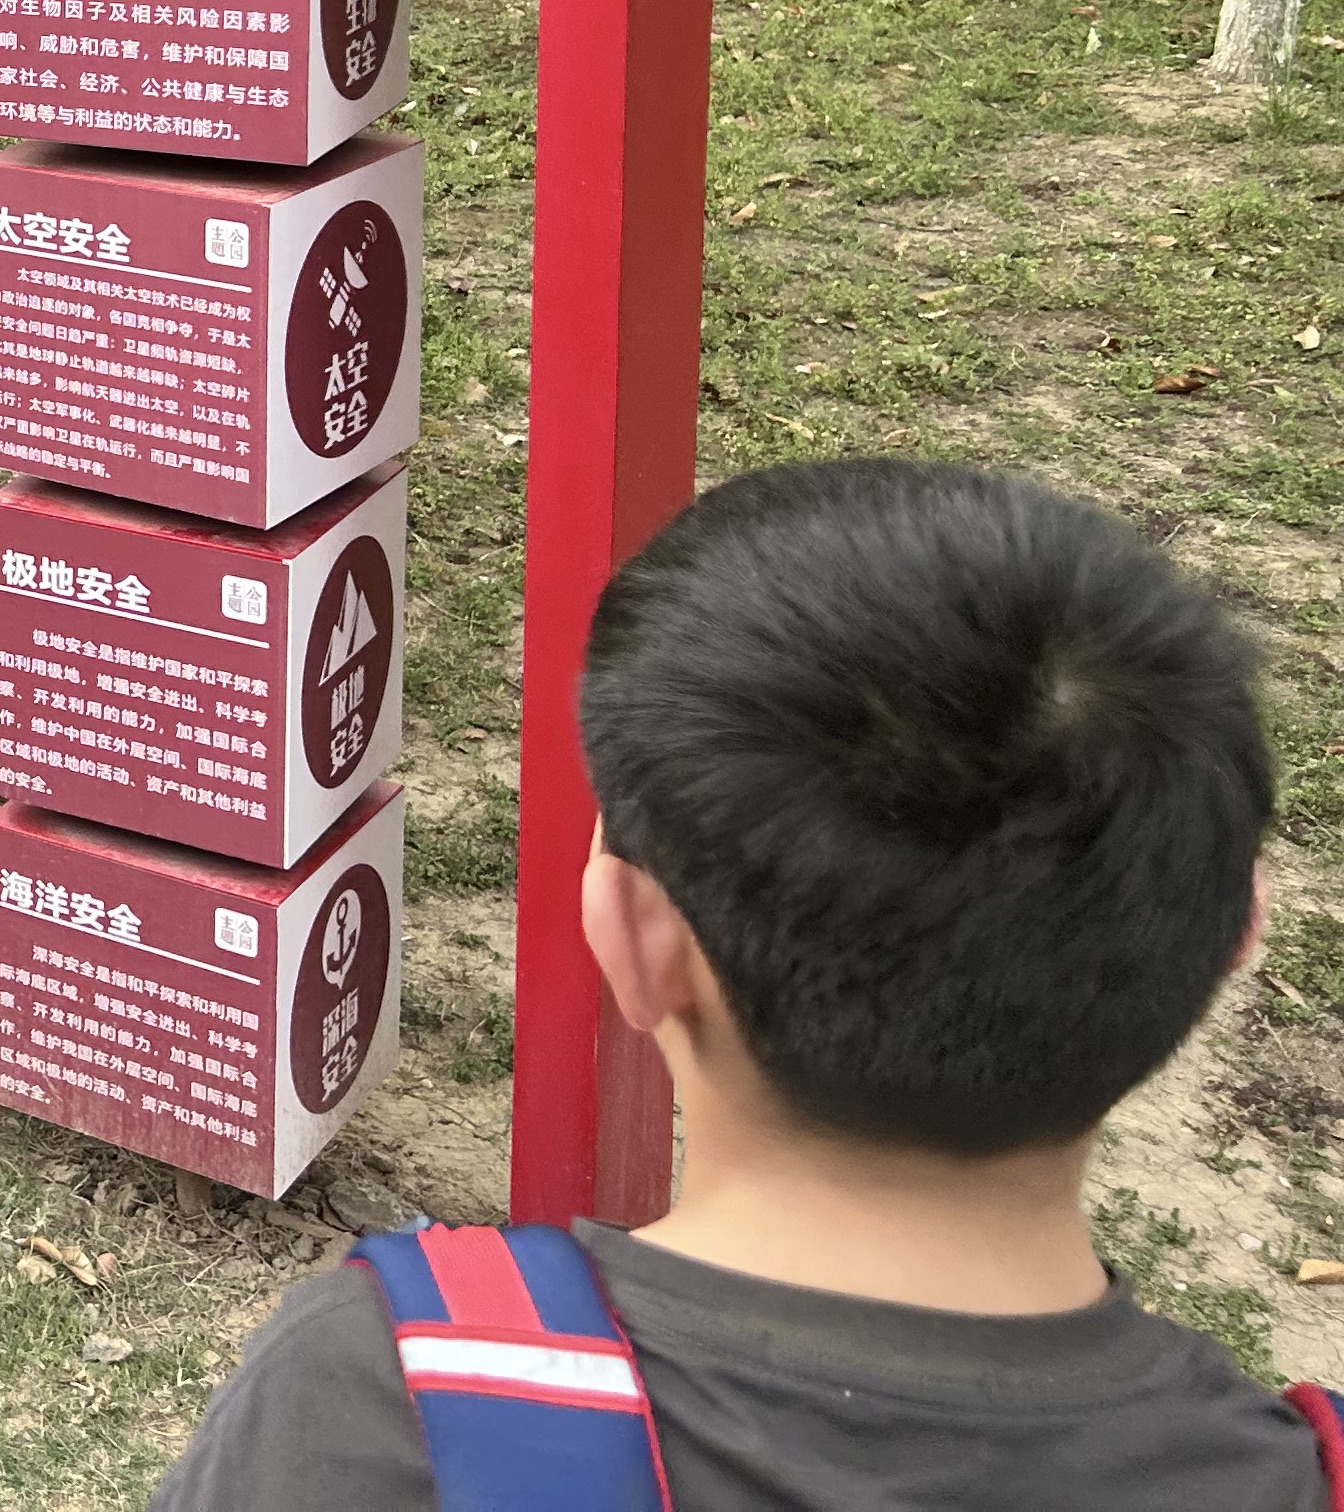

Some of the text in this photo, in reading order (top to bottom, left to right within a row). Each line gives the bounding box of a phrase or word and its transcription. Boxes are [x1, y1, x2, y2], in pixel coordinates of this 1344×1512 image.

[1, 548, 151, 614] 极地安全
[32, 628, 269, 698] 极地安全是指维护国家和平探索
[0, 868, 143, 943] 海洋安全
